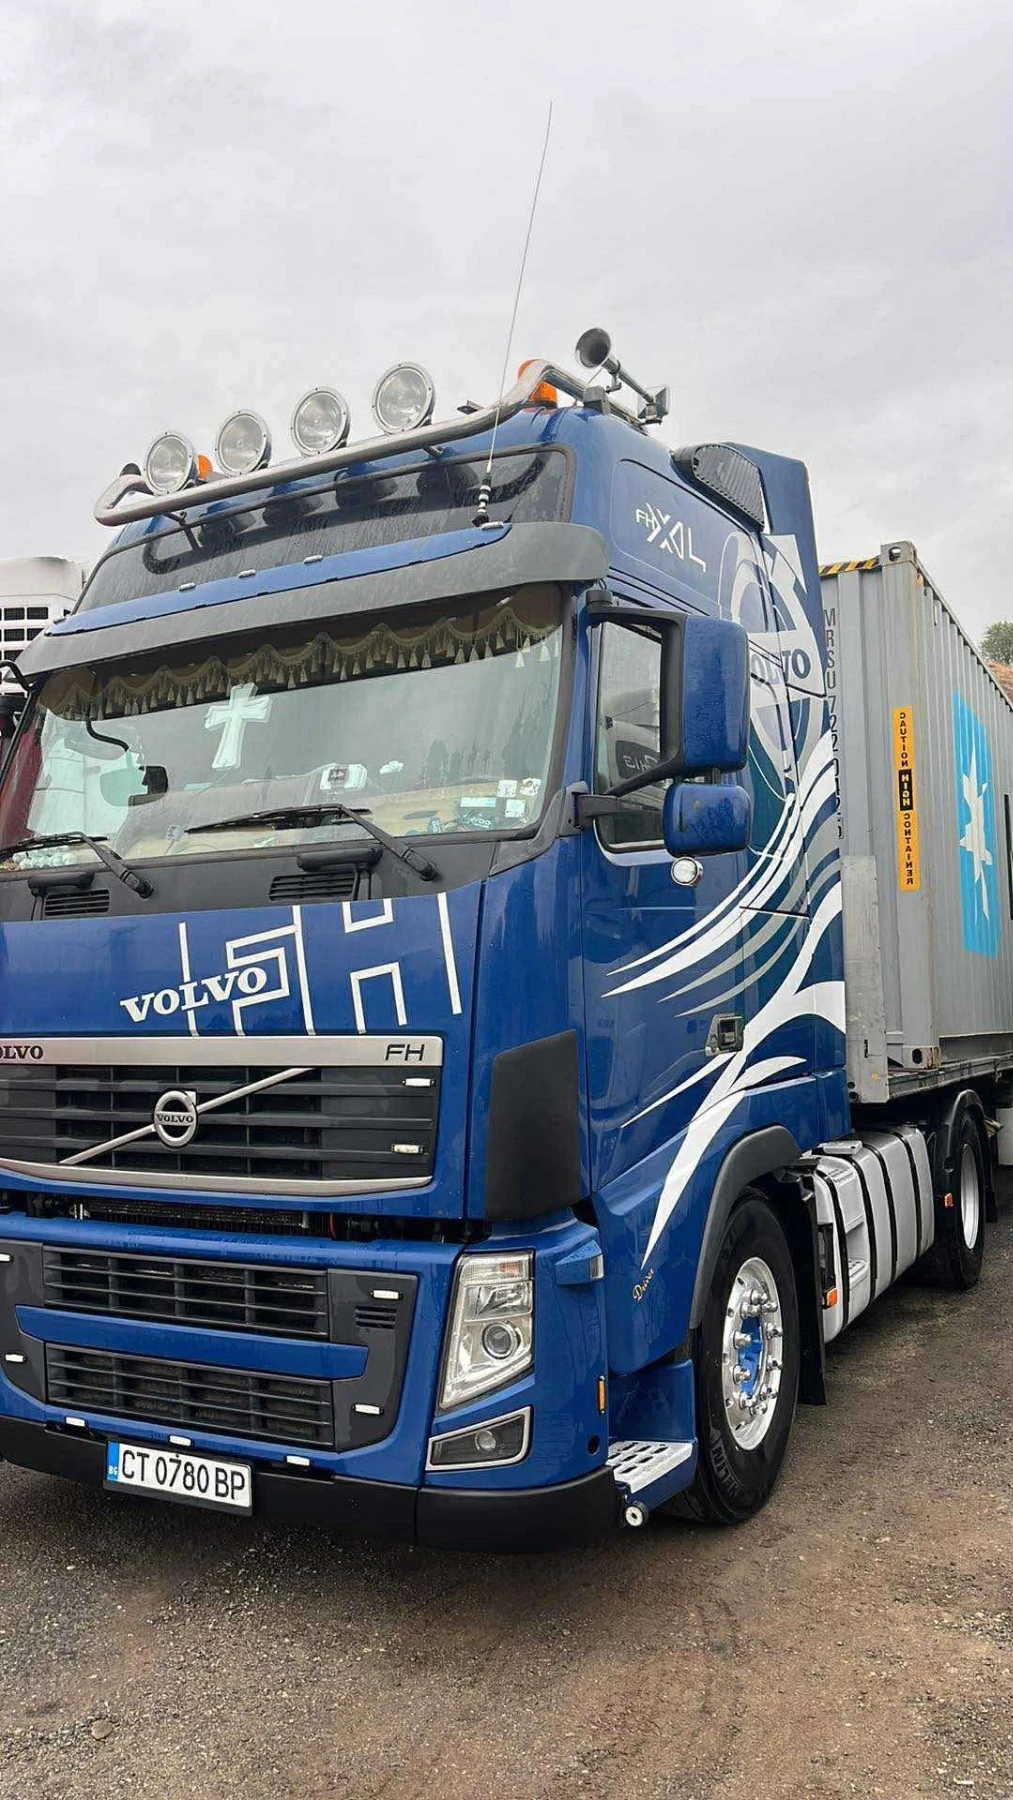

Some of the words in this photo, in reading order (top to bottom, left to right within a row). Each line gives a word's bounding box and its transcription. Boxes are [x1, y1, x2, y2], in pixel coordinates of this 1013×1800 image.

[824, 607, 836, 690] MRSU
[120, 966, 268, 1023] VOLVO
[0, 1045, 43, 1060] LVO
[385, 1043, 425, 1062] FH
[156, 1113, 194, 1124] VOLVO
[108, 1465, 118, 1476] BG
[122, 1449, 149, 1482] CT
[155, 1456, 209, 1494] 0780
[215, 1467, 246, 1500] BP
